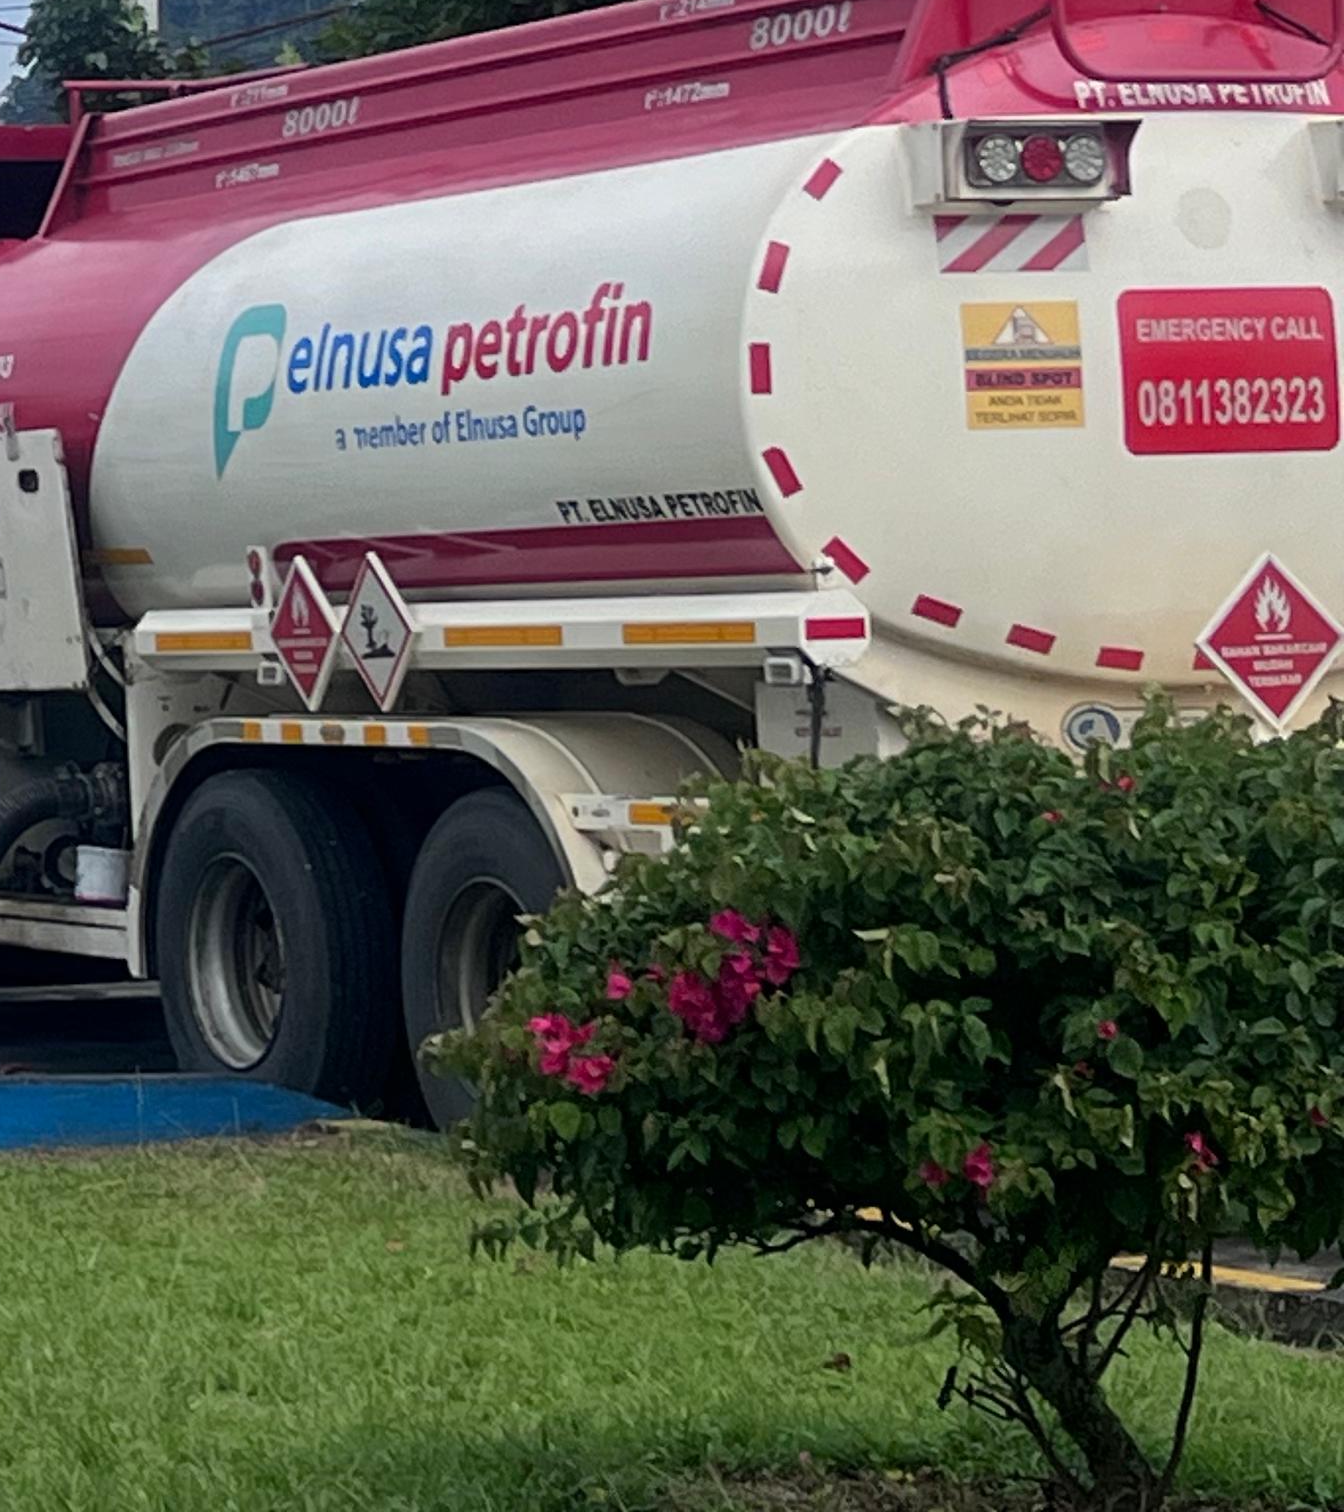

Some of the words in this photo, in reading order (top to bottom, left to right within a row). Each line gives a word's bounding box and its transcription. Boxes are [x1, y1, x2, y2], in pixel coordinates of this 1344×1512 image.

[1073, 80, 1116, 108] PT.
[1117, 81, 1215, 106] ELNUSA
[287, 322, 434, 394] elnusa
[440, 282, 653, 396] petrofin
[1136, 316, 1267, 342] EMERGENCY
[1270, 316, 1325, 340] CALL
[975, 372, 1025, 387] BLIND
[1031, 371, 1073, 386] SPOT
[1138, 377, 1326, 427] 0811382323
[335, 428, 347, 451] a
[353, 415, 428, 450] member
[432, 410, 454, 443] of
[456, 407, 518, 442] Elnusa
[522, 405, 586, 441] Group
[556, 500, 590, 524] PT.
[587, 495, 667, 522] ELNUSA
[663, 488, 765, 519] PETROFIN
